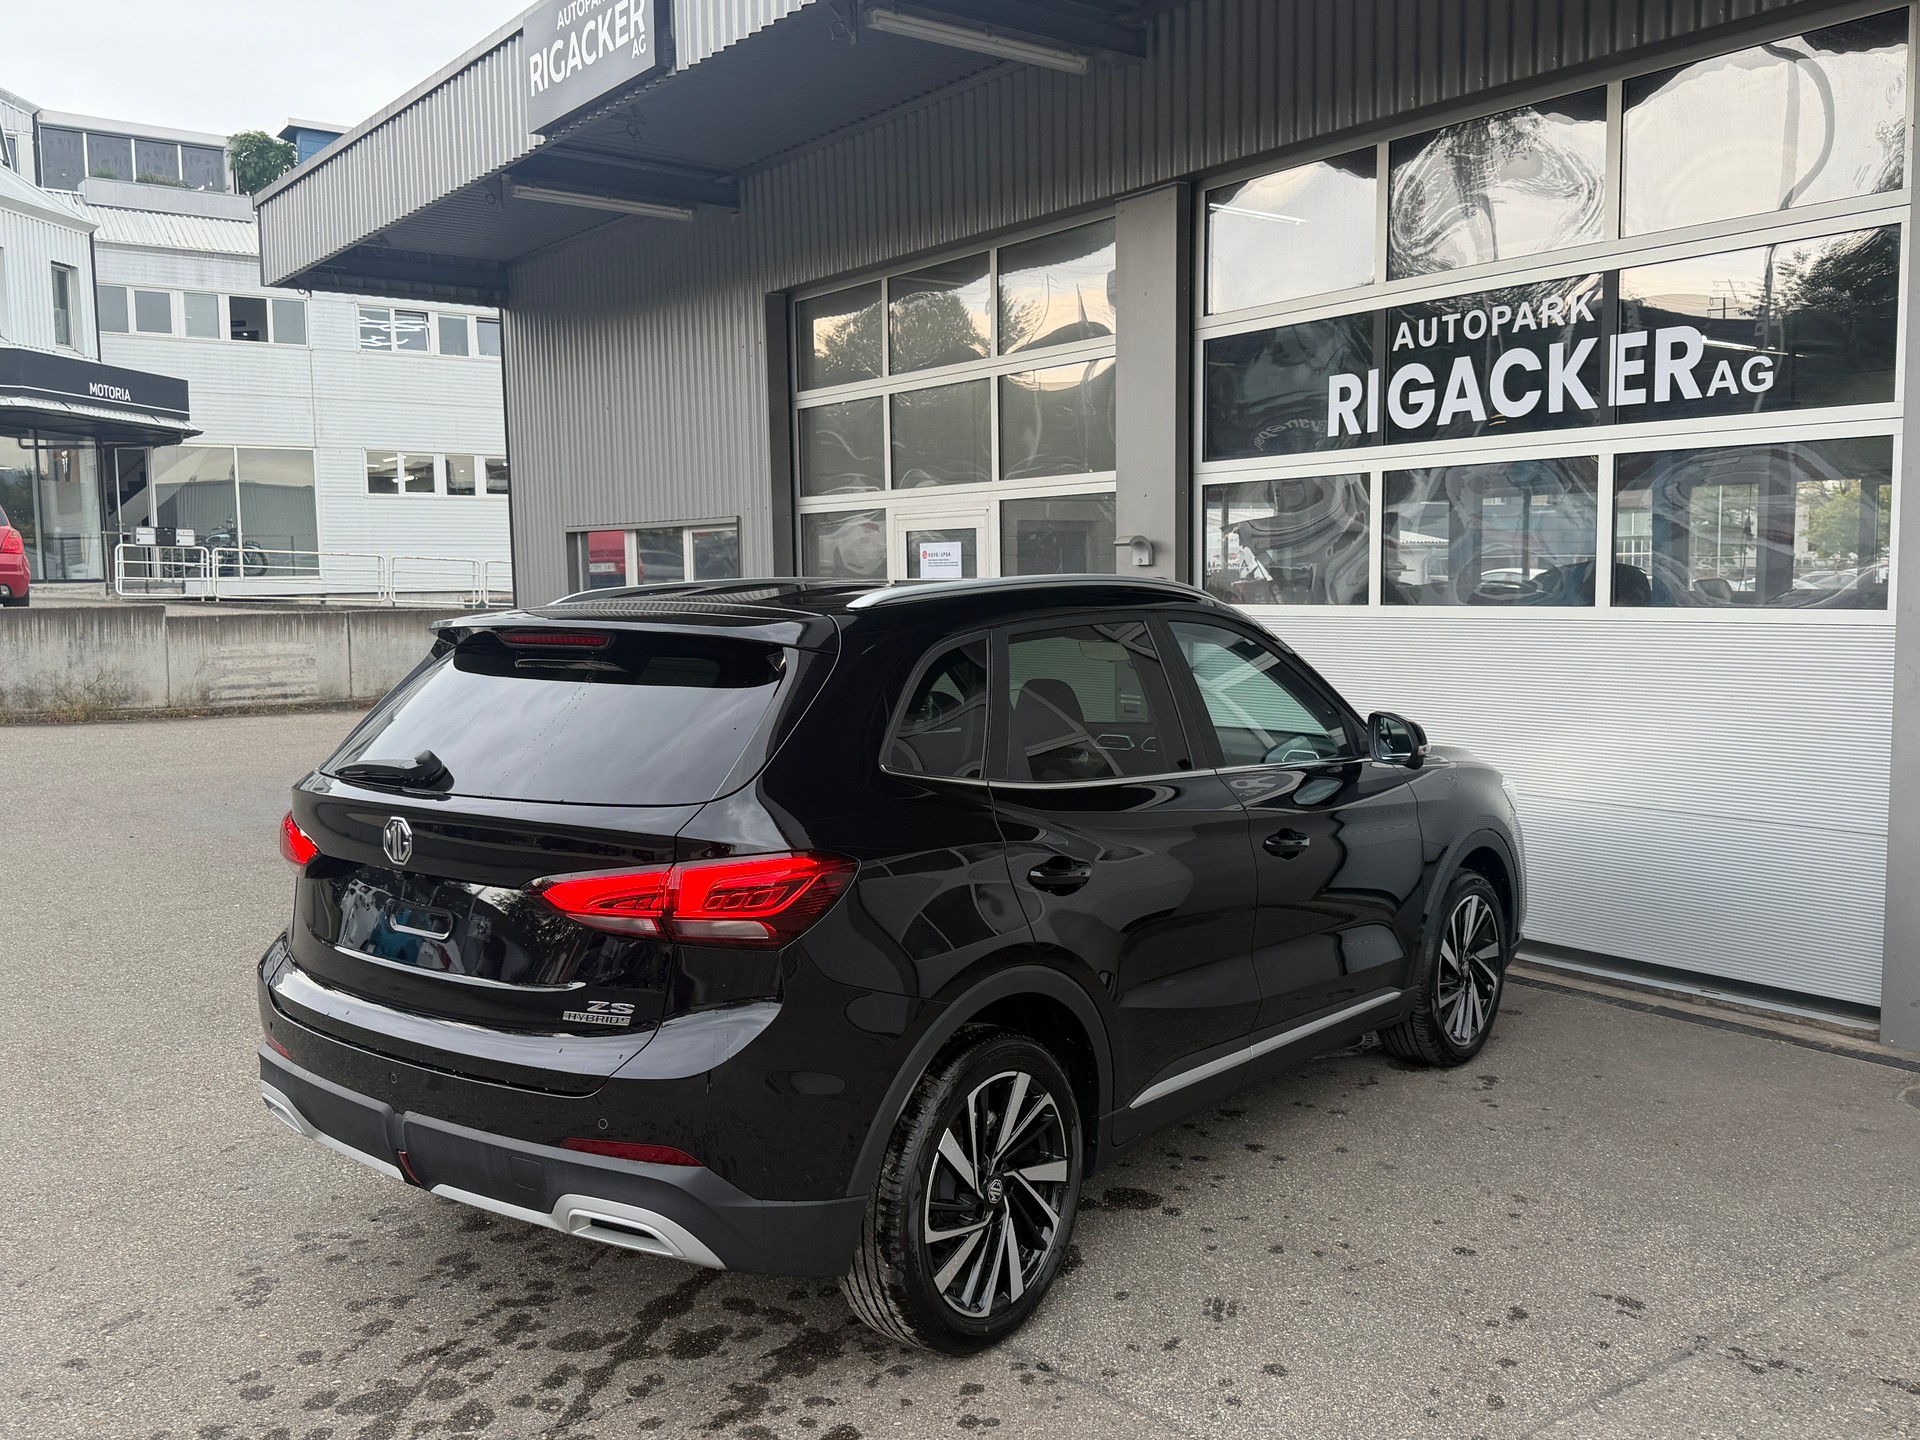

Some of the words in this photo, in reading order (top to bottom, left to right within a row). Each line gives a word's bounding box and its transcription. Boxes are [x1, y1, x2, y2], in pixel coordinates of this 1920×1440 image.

[557, 0, 605, 31] AUTOP
[529, 0, 646, 97] RIGACKER
[632, 34, 646, 59] AG
[1392, 290, 1595, 352] AUTOPARK
[89, 382, 132, 401] MOTORIA
[1327, 325, 1704, 437] RIGACKER
[1706, 355, 1774, 398] AG
[385, 818, 411, 863] MG
[587, 1000, 636, 1015] ZS
